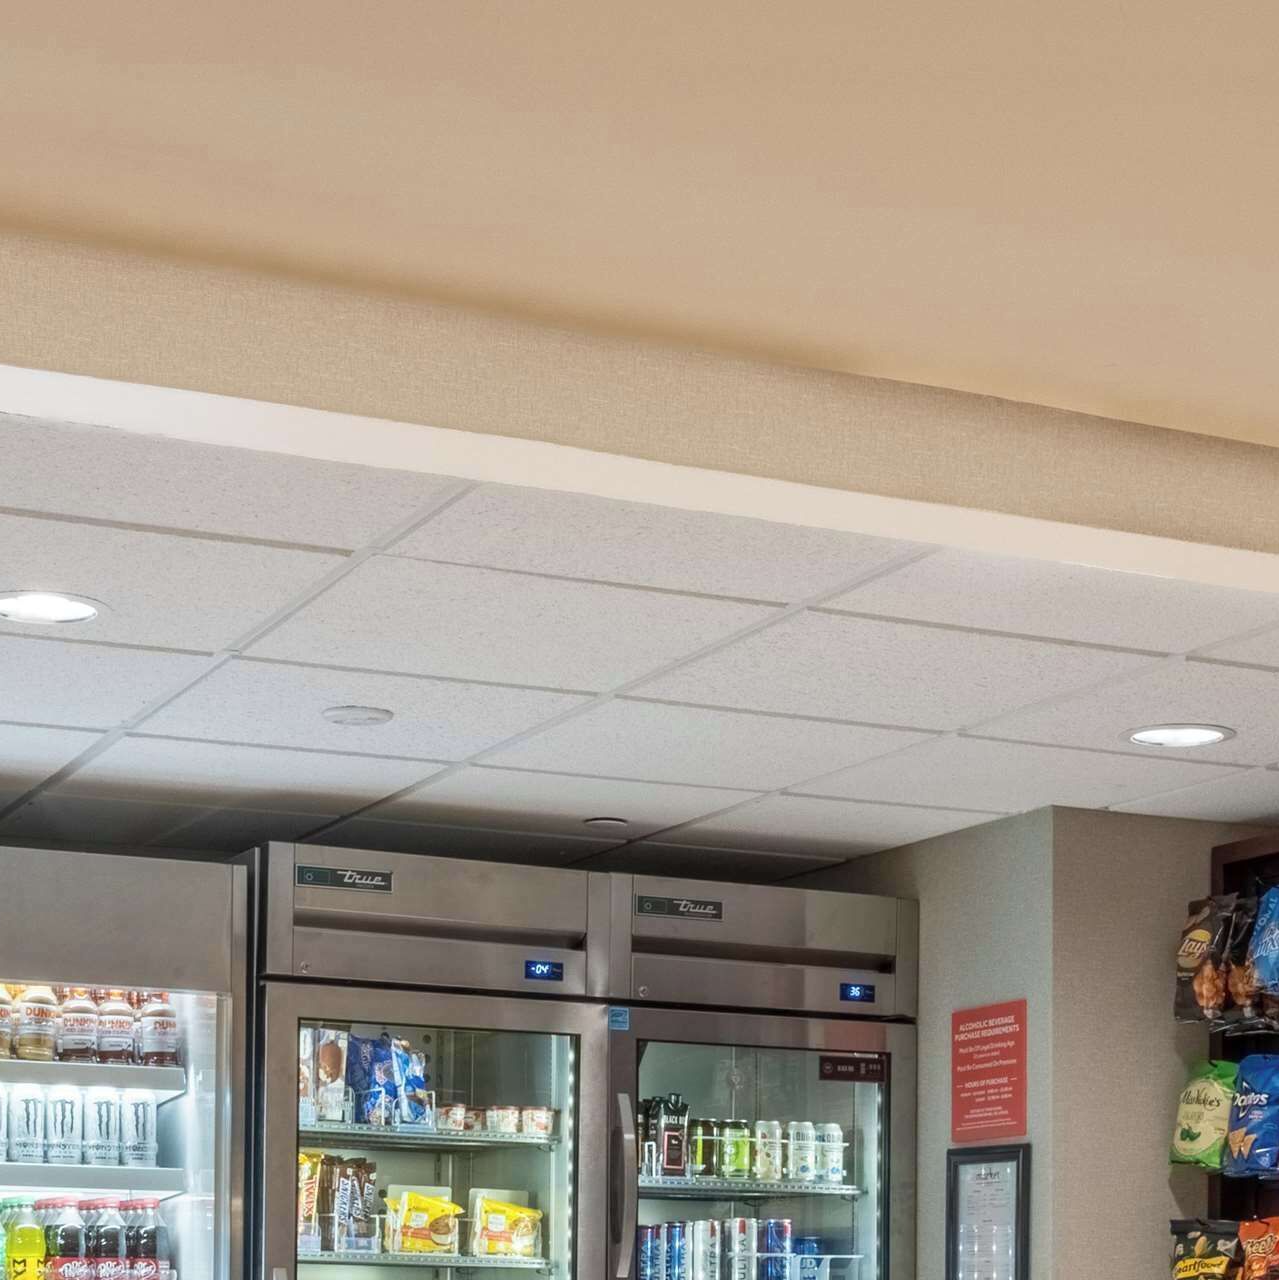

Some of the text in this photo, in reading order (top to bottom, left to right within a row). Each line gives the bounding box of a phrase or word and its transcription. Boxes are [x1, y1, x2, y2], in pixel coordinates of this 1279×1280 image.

[850, 986, 861, 997] 36
[960, 1015, 1015, 1032] ALCOHOLIC BEVERAGE
[955, 1024, 1019, 1042] PURCHASE REQUIREMENTS
